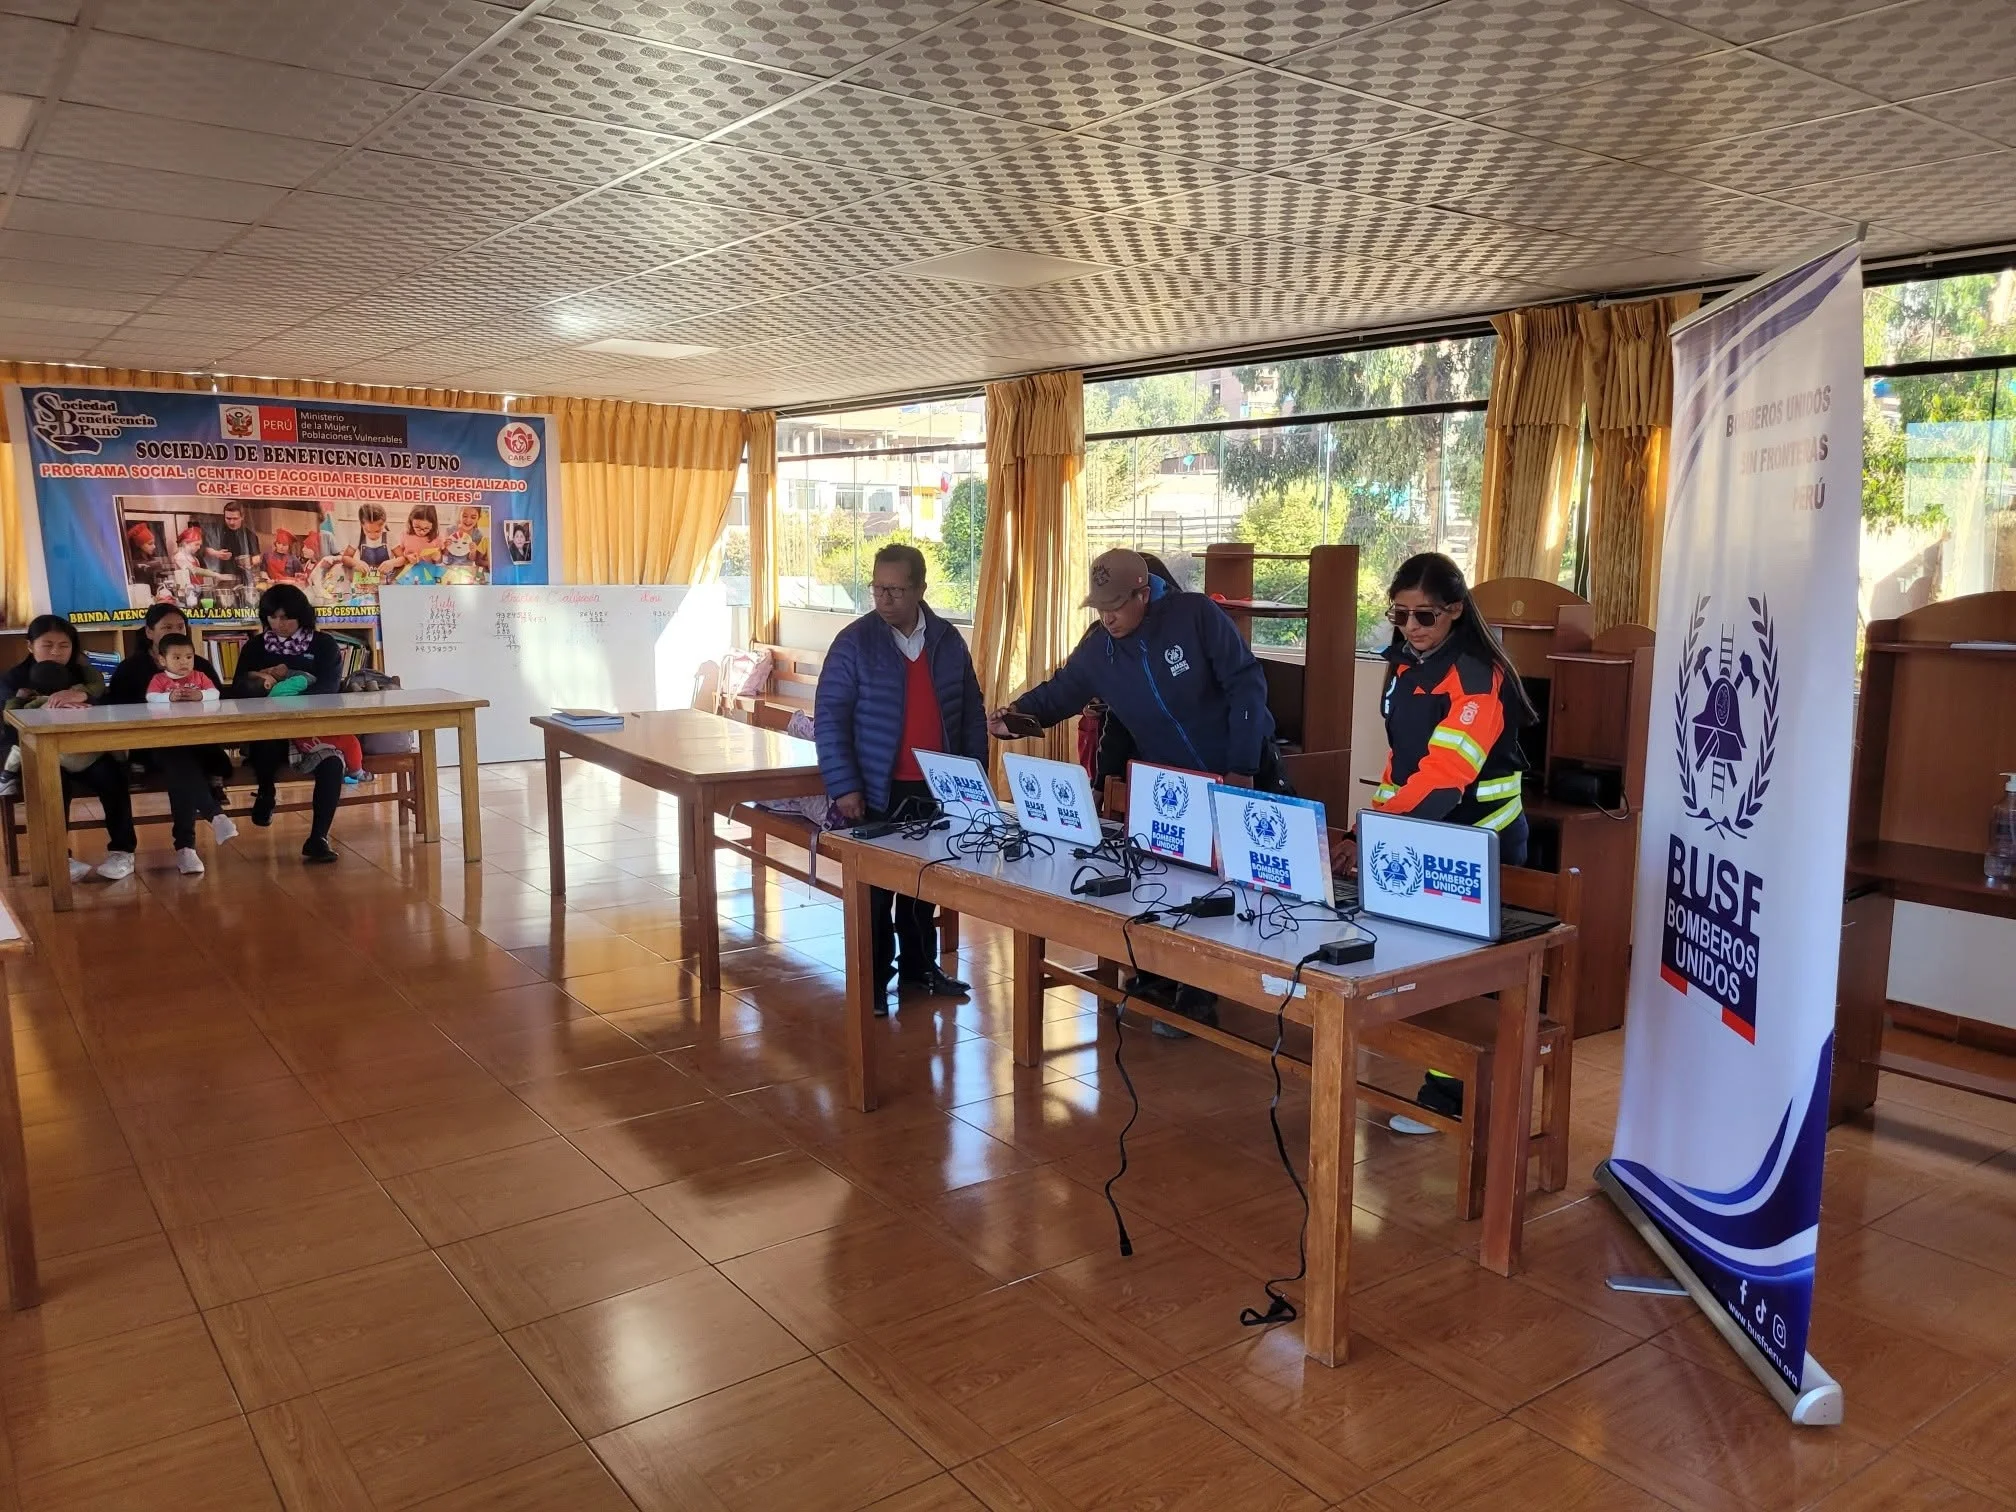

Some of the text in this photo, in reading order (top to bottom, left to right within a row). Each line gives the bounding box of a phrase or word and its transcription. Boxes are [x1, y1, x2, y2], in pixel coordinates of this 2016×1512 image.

[300, 412, 345, 422] Ministerio
[1726, 385, 1832, 437] BOMBEROS UNIDOS
[80, 425, 120, 436] Puno
[263, 419, 293, 431] PERÚ
[314, 422, 322, 430] la
[324, 423, 350, 432] Mujer
[351, 425, 357, 433] y
[302, 430, 403, 444] Poblaciones Vulnerables
[136, 441, 460, 471] SOCIEDAD DE BENEFICENCIA DE PUNO
[1740, 434, 1829, 475] SIN FRONTERAS
[41, 464, 127, 477] PROGRAMA
[131, 466, 186, 478] SOCIAL
[197, 467, 254, 480] CENTRO
[258, 470, 276, 480] DE
[280, 470, 341, 483] ACOGIDA
[344, 473, 428, 487] RESIDENCIAL
[432, 478, 527, 491] ESPECIALIZADO
[198, 483, 239, 495] CAR-E
[253, 484, 317, 497] CESAREA
[320, 487, 355, 498] LUNA
[359, 489, 401, 500] OLVEA
[404, 490, 421, 500] DE
[425, 491, 471, 502] FLORES
[1793, 477, 1826, 512] PERÚ
[69, 613, 110, 623] BRINDA
[334, 606, 380, 617] GESTANTES
[953, 775, 983, 791] BUSF
[1025, 800, 1044, 811] BUSF
[1057, 807, 1078, 818] BUSF
[1152, 820, 1185, 838] BUSF
[1152, 831, 1184, 846] BOMBEROS
[1156, 839, 1179, 852] UNIDOS
[1249, 850, 1289, 870] BUSF
[1423, 854, 1481, 881] BUSF
[1251, 862, 1289, 878] BOMBEROS
[1257, 870, 1285, 884] UNIDOS
[1425, 869, 1480, 889] BOMBEROS
[1666, 833, 1763, 935] BUSF
[1432, 879, 1472, 896] UNIDOS
[1667, 897, 1756, 978] BOMBEROS
[1675, 936, 1740, 1005] UNIDOS
